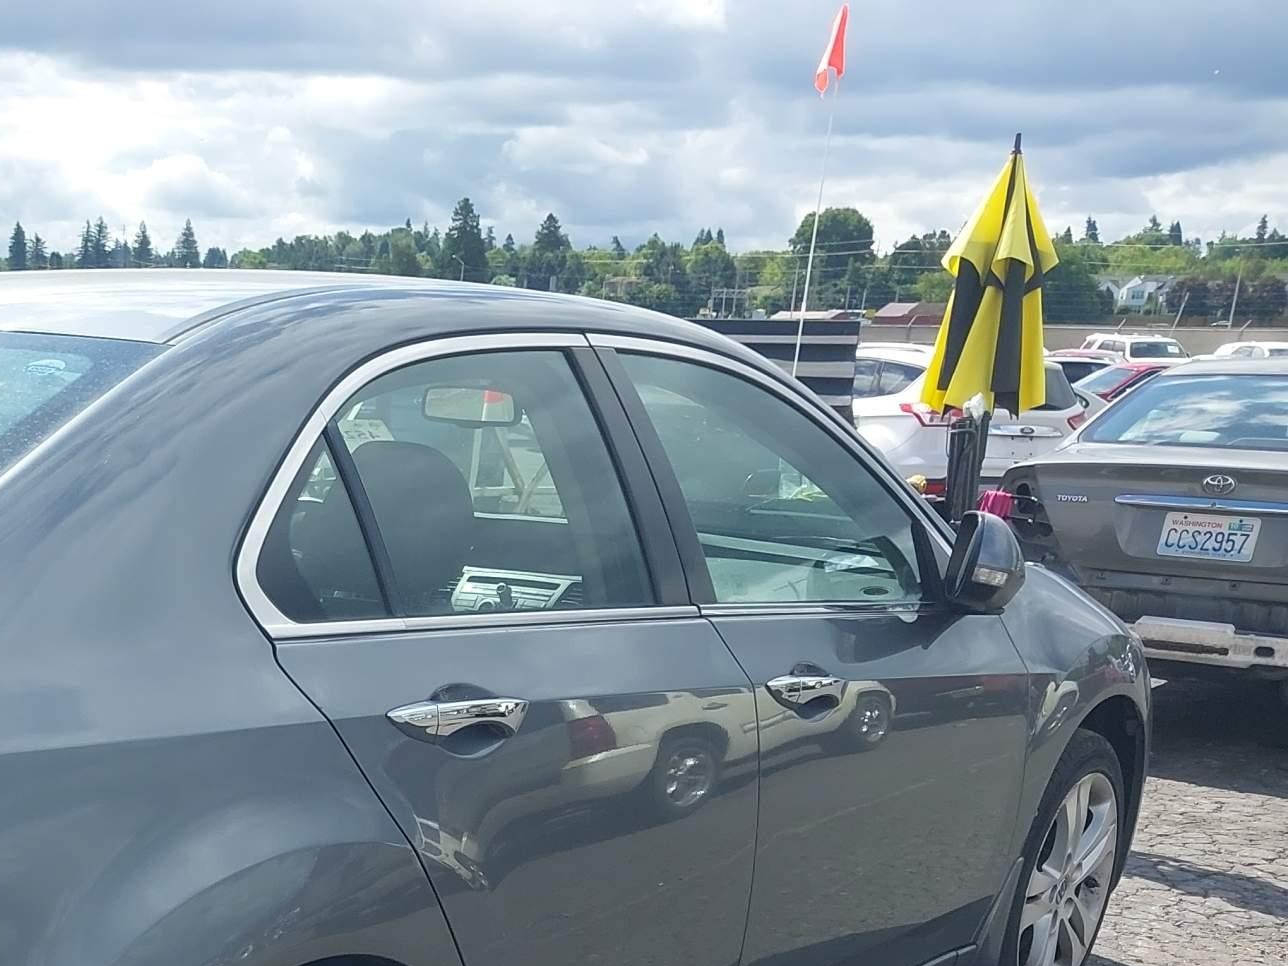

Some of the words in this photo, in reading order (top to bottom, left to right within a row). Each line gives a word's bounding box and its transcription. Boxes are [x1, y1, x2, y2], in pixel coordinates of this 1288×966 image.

[1056, 494, 1088, 502] TOYOTA
[1172, 519, 1223, 529] WASHINGTON
[1165, 528, 1250, 554] CCS2957
